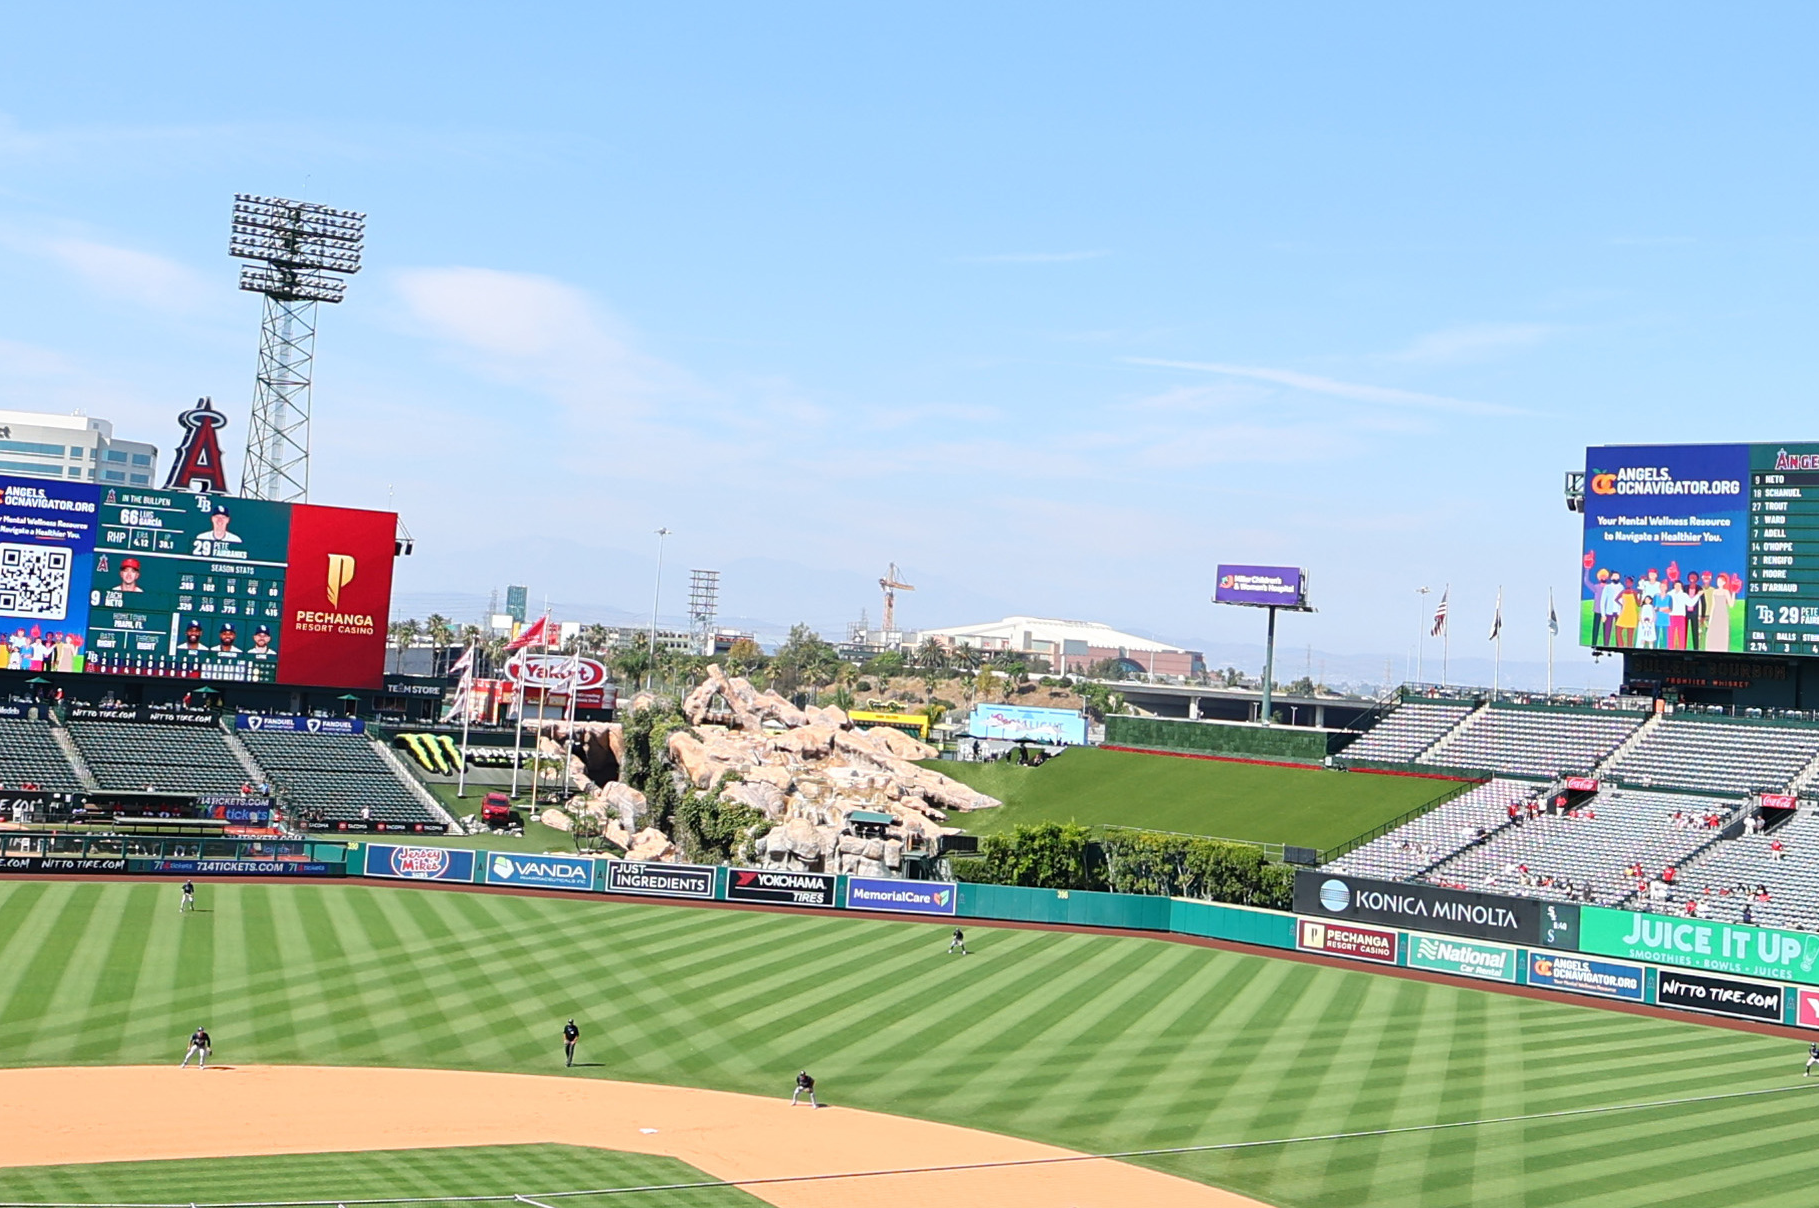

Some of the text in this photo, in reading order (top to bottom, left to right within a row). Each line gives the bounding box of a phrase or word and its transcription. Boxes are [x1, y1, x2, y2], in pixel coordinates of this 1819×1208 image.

[1617, 467, 1672, 481] ANGELS.
[1617, 480, 1740, 496] OCNAVIGATOR.ORG
[5, 498, 96, 513] OCNAVIGATOR.ORG
[1618, 516, 1731, 527] Mental Wellness Resource
[1660, 533, 1702, 543] Healthier
[296, 611, 374, 626] PECHANGA
[1779, 606, 1799, 625] 29
[296, 623, 374, 635] RESORT CASINO
[412, 686, 441, 695] STORE
[72, 709, 136, 720] NITTO TIRE.COM
[149, 712, 212, 724] NITTO TIRE.COM
[399, 846, 442, 862] Jersey
[41, 858, 125, 871] NITTO TIRE.COM
[196, 862, 284, 872] 714TICKETS.COM
[514, 862, 586, 880] VANDA
[618, 863, 646, 876] JUST
[616, 873, 708, 892] INGREDIENTS
[757, 871, 827, 890] YOKOHAMA
[792, 891, 825, 904] TIRES
[853, 888, 932, 905] MemorialCare
[1356, 890, 1518, 929] KONICA MINOLTA
[1327, 929, 1390, 948] PECHANGA
[1623, 913, 1713, 954] JUICE
[1722, 927, 1751, 959] IT
[1437, 942, 1507, 968] National
[1460, 963, 1502, 977] Car Rental
[1629, 949, 1793, 980] SMOOTHIES BOWLS JUICES
[1553, 968, 1638, 990] OCNAVIGATOR.ORG
[1662, 979, 1778, 1011] NITTO TIRE.COM
